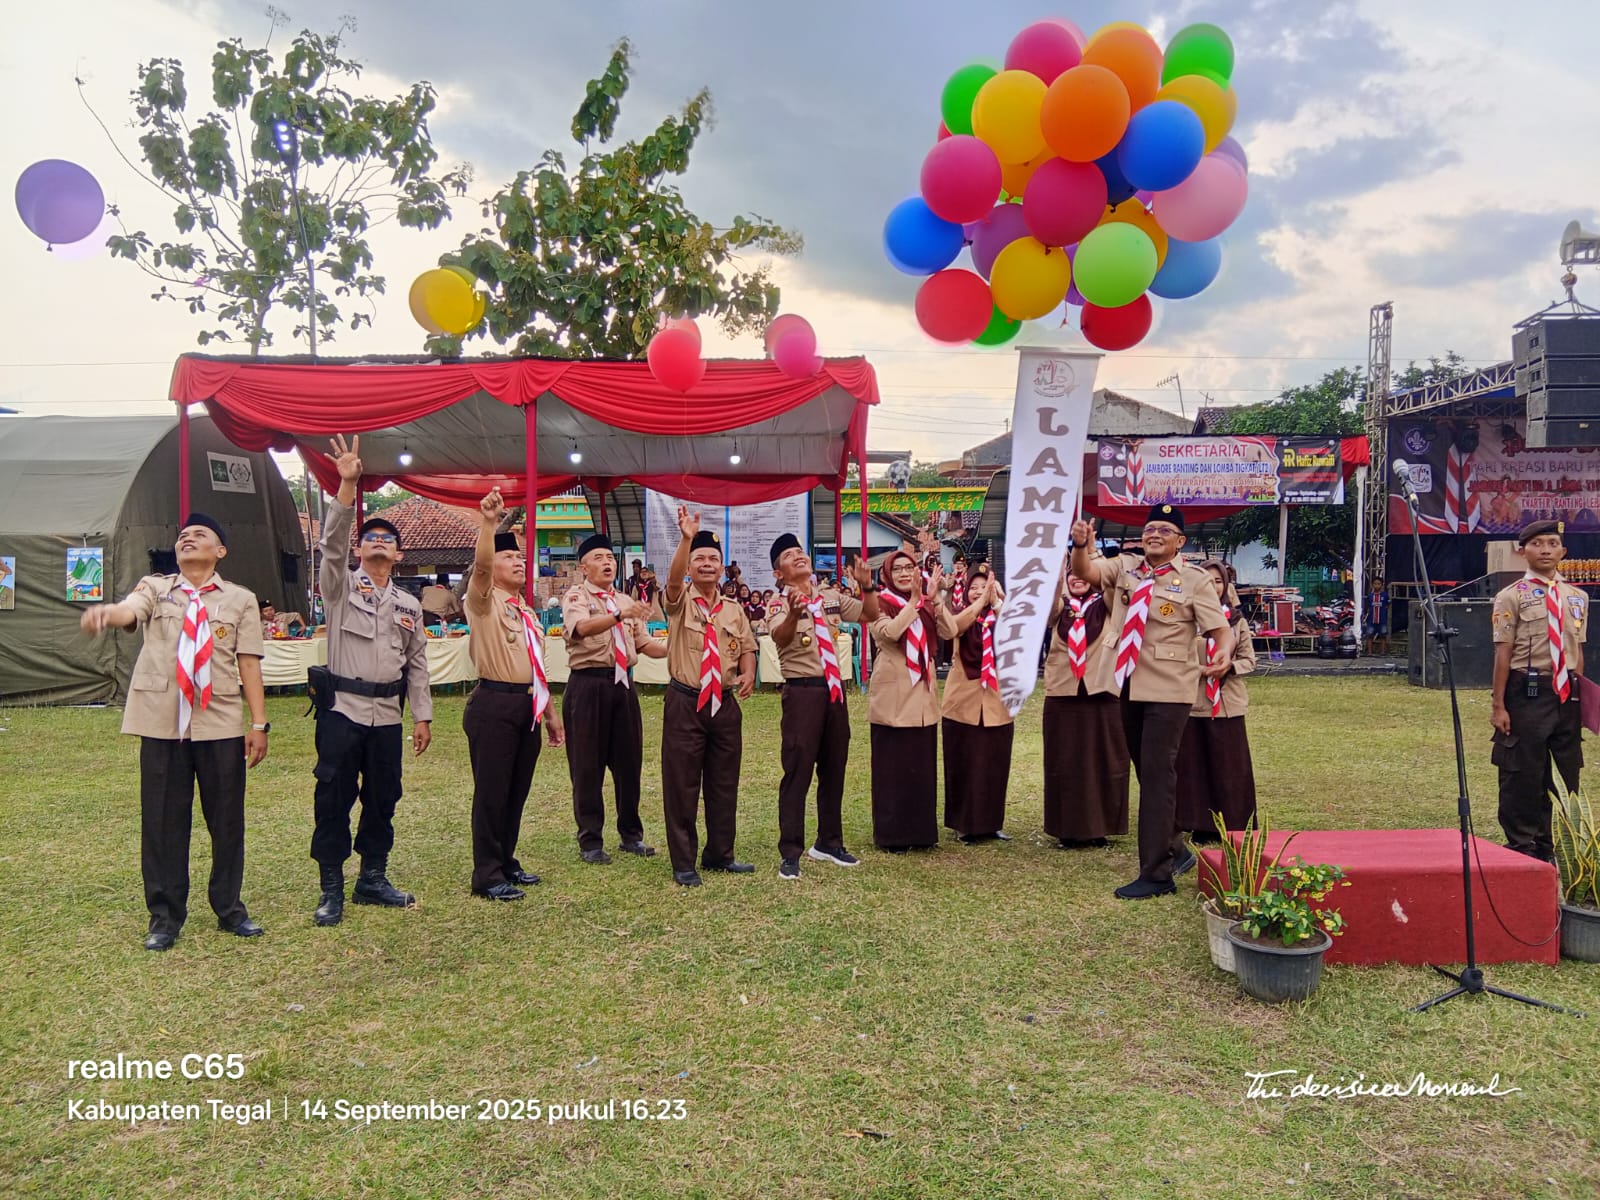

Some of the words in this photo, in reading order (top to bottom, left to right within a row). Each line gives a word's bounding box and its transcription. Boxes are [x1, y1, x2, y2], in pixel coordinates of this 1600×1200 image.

[1159, 444, 1248, 458] SEKRETARIAT
[1145, 462, 1172, 474] JAMBORE
[1173, 462, 1199, 474] RANTING
[1199, 462, 1212, 474] DAN
[1213, 462, 1234, 474] LOMBA
[1501, 460, 1545, 473] KREASI
[1549, 459, 1583, 473] BARU
[394, 604, 416, 617] POLRI
